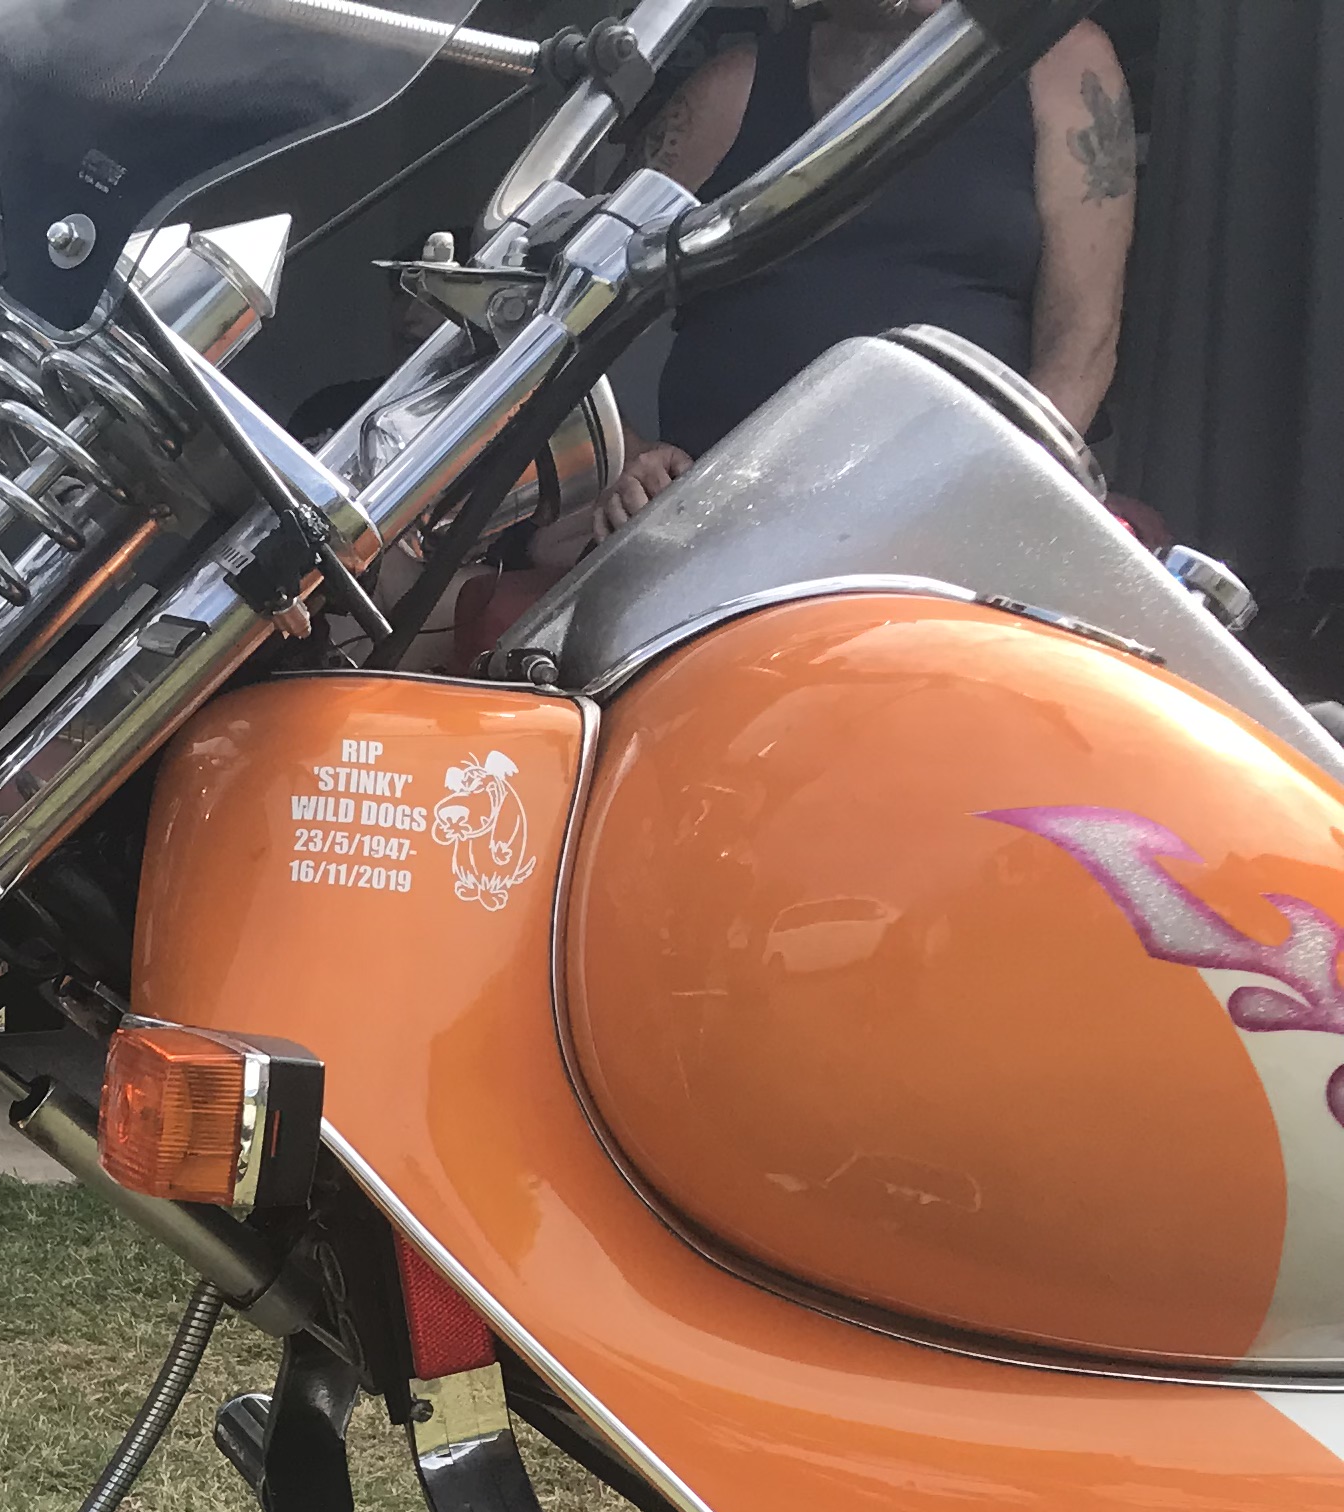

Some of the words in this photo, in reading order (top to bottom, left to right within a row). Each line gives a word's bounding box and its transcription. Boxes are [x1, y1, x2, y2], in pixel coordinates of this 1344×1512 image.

[342, 739, 383, 764] RIP
[314, 766, 413, 798] 'STINKY'
[291, 795, 355, 823] WILD
[360, 801, 428, 832] DOGS
[294, 828, 417, 861] 23/5/1947-
[289, 859, 412, 893] 16/11/2019
